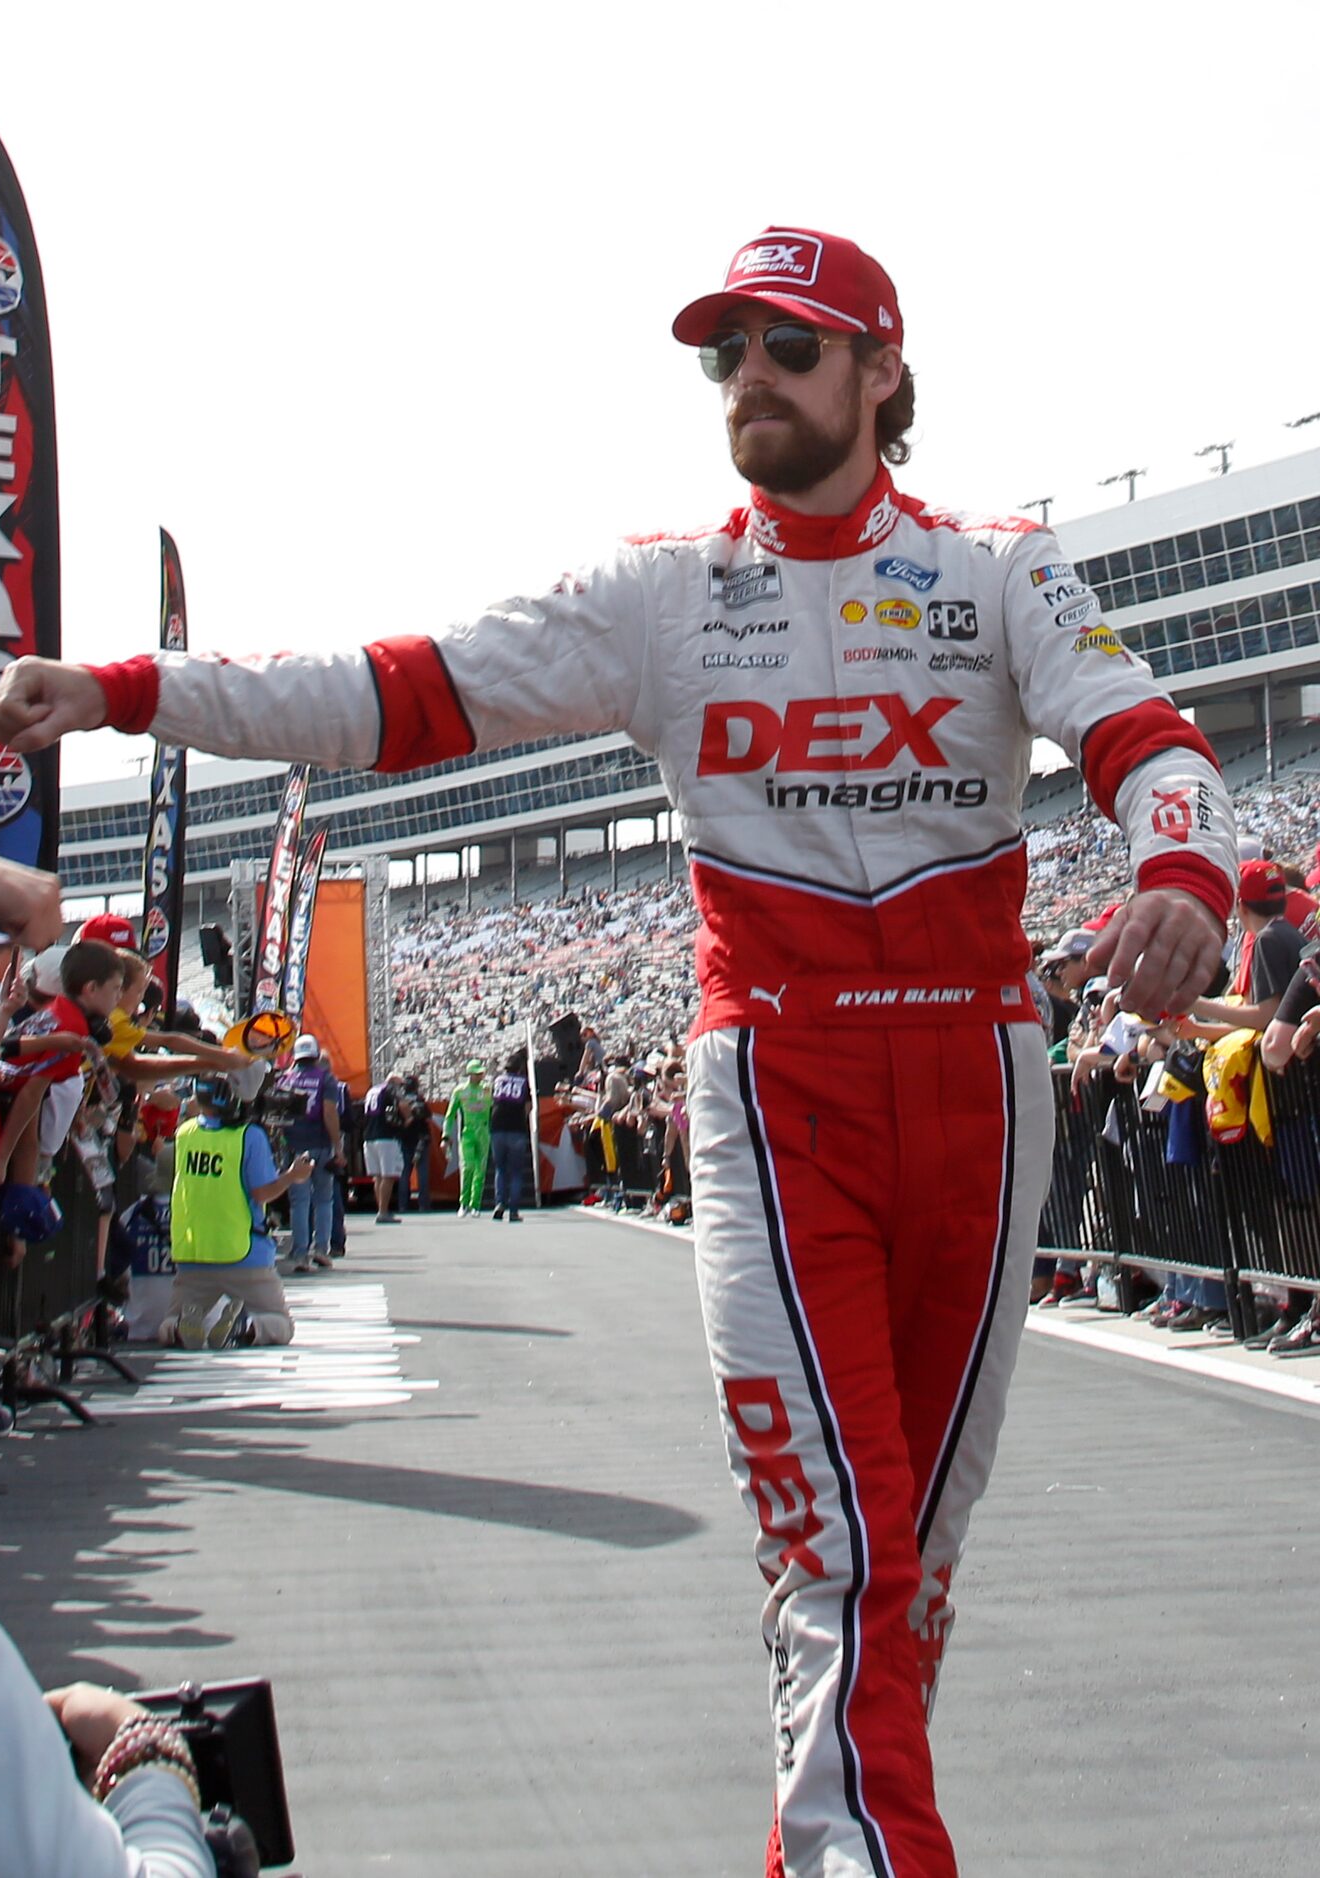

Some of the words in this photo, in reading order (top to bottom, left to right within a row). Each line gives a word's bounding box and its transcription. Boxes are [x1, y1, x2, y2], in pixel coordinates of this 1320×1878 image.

[733, 243, 803, 272] DEX
[743, 261, 805, 275] imaging
[886, 558, 934, 589] Ford
[928, 604, 977, 637] PPG
[697, 692, 965, 778] DEX
[765, 771, 989, 813] imaging
[262, 817, 297, 975] TEXAS
[285, 891, 311, 1014] TEXAS
[835, 988, 899, 1007] RYAN
[902, 987, 977, 1004] BLANEY
[186, 1151, 223, 1178] NBC
[723, 1378, 830, 1586] DEX
